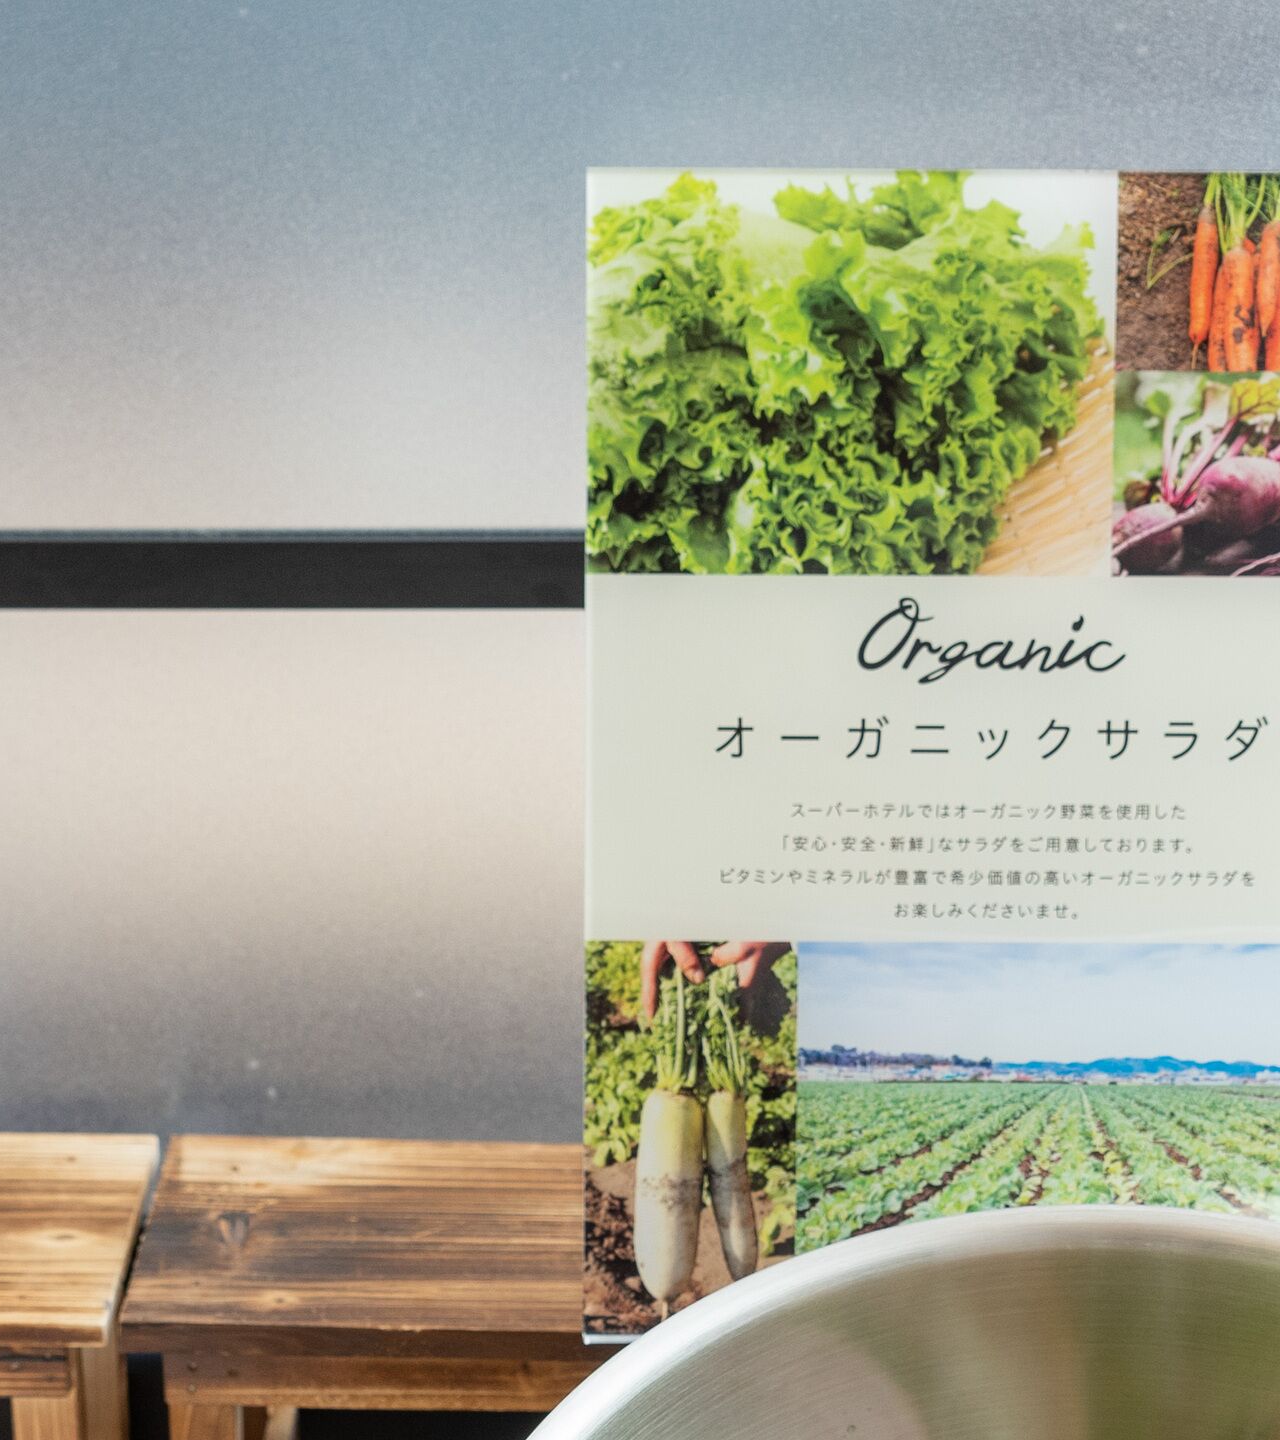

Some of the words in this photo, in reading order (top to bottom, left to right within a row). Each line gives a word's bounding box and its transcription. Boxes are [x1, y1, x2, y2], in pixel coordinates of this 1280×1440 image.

[857, 597, 1126, 684] Organic
[714, 715, 1269, 761] オーガニックサラダ
[790, 802, 1187, 821] スーパーホテルではオーガニック野菜を使用した
[719, 868, 1256, 887] ビタミンやミネラルが豊富で希少価値の高いオーガニックサラダを
[894, 902, 1079, 920] お楽しみくださいませ。
